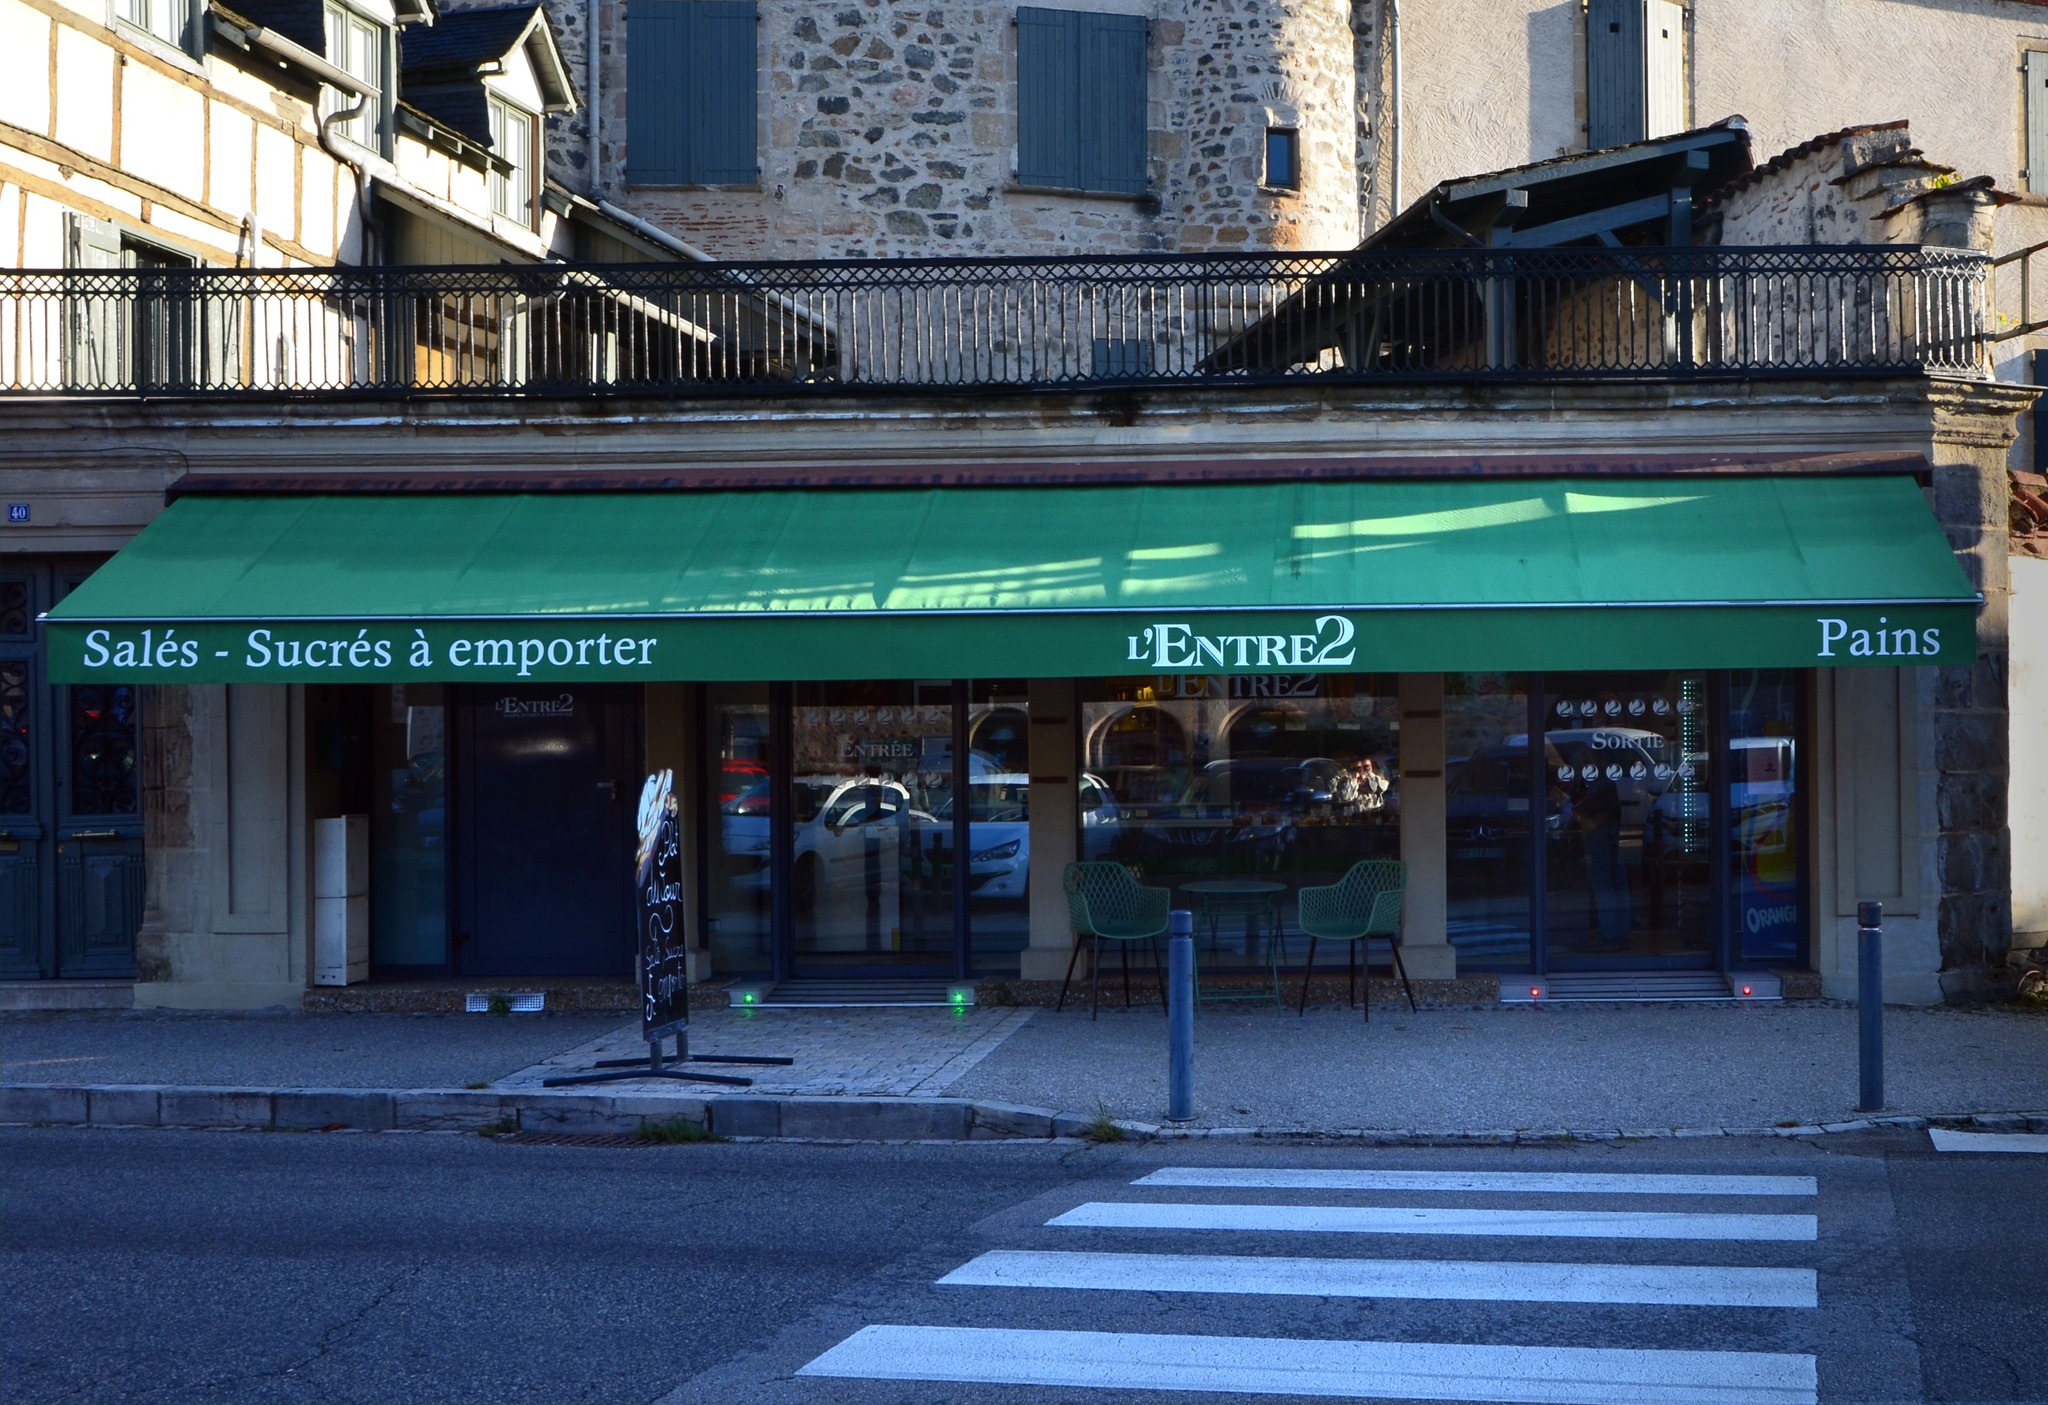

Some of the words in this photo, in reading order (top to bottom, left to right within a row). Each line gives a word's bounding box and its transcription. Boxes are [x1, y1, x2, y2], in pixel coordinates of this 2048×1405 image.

[11, 506, 26, 519] 40
[1817, 617, 1940, 656] Pains
[83, 629, 198, 667] Salés
[246, 629, 392, 667] Sucrés
[409, 628, 433, 667] à
[449, 633, 657, 676] emporter
[1557, 700, 1573, 716] 2
[1581, 700, 1597, 716] 2
[1605, 700, 1621, 716] 2
[1629, 699, 1645, 715] 2
[1653, 699, 1669, 715] 2
[1558, 765, 1574, 781] 2
[1582, 765, 1598, 781] 2
[1606, 764, 1622, 780] 2
[1630, 764, 1646, 780] 2
[1654, 763, 1670, 779] 2
